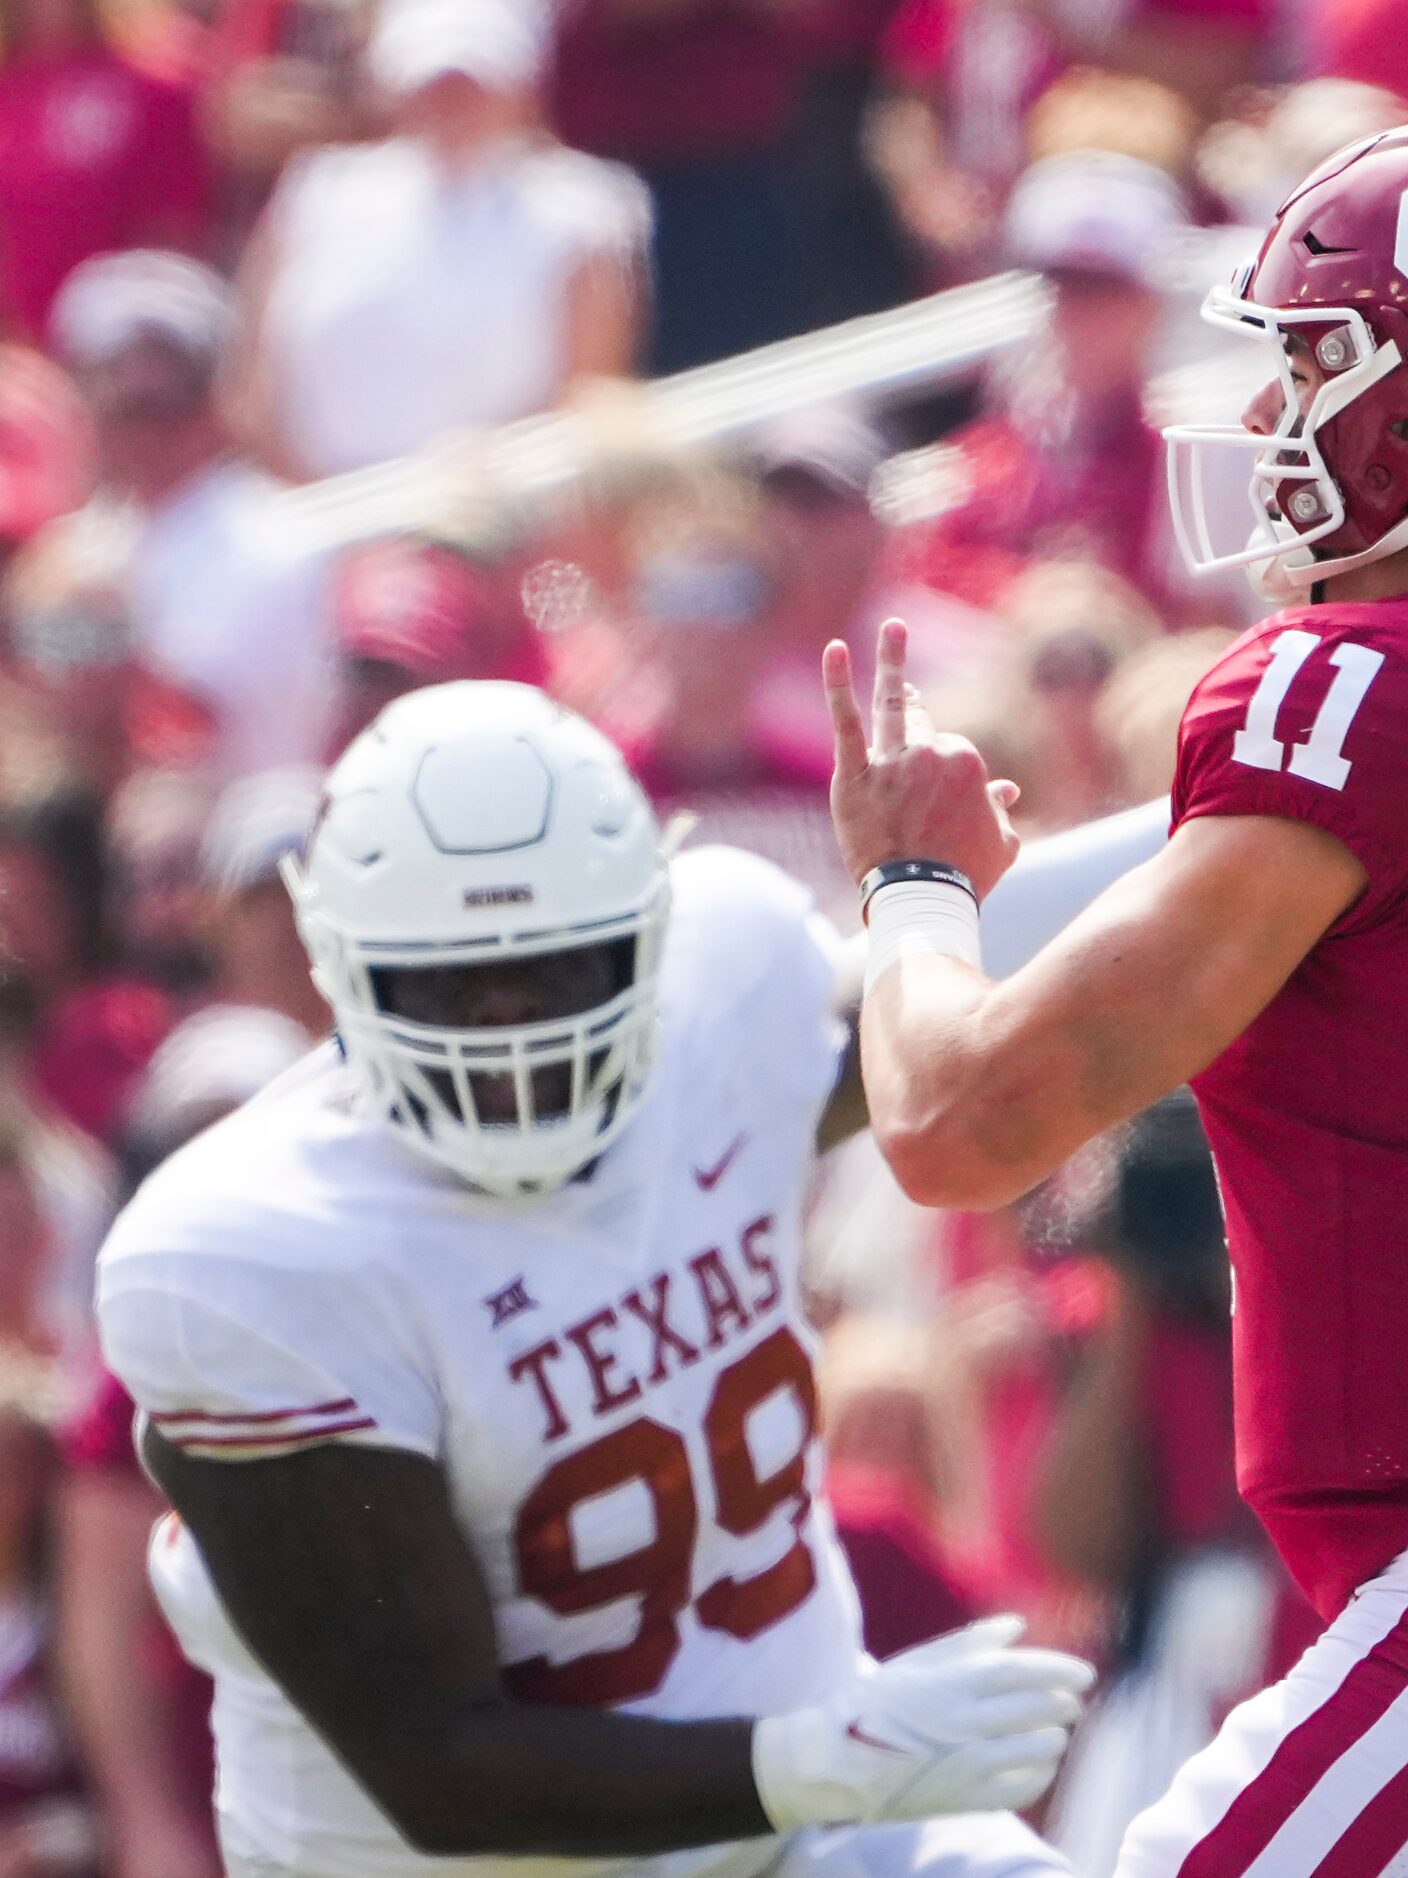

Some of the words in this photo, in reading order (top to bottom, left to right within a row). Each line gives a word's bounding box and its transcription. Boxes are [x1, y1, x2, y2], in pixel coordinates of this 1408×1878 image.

[1232, 630, 1387, 791] 11
[508, 1215, 784, 1442] TEXAS
[502, 1323, 820, 1710] 99
